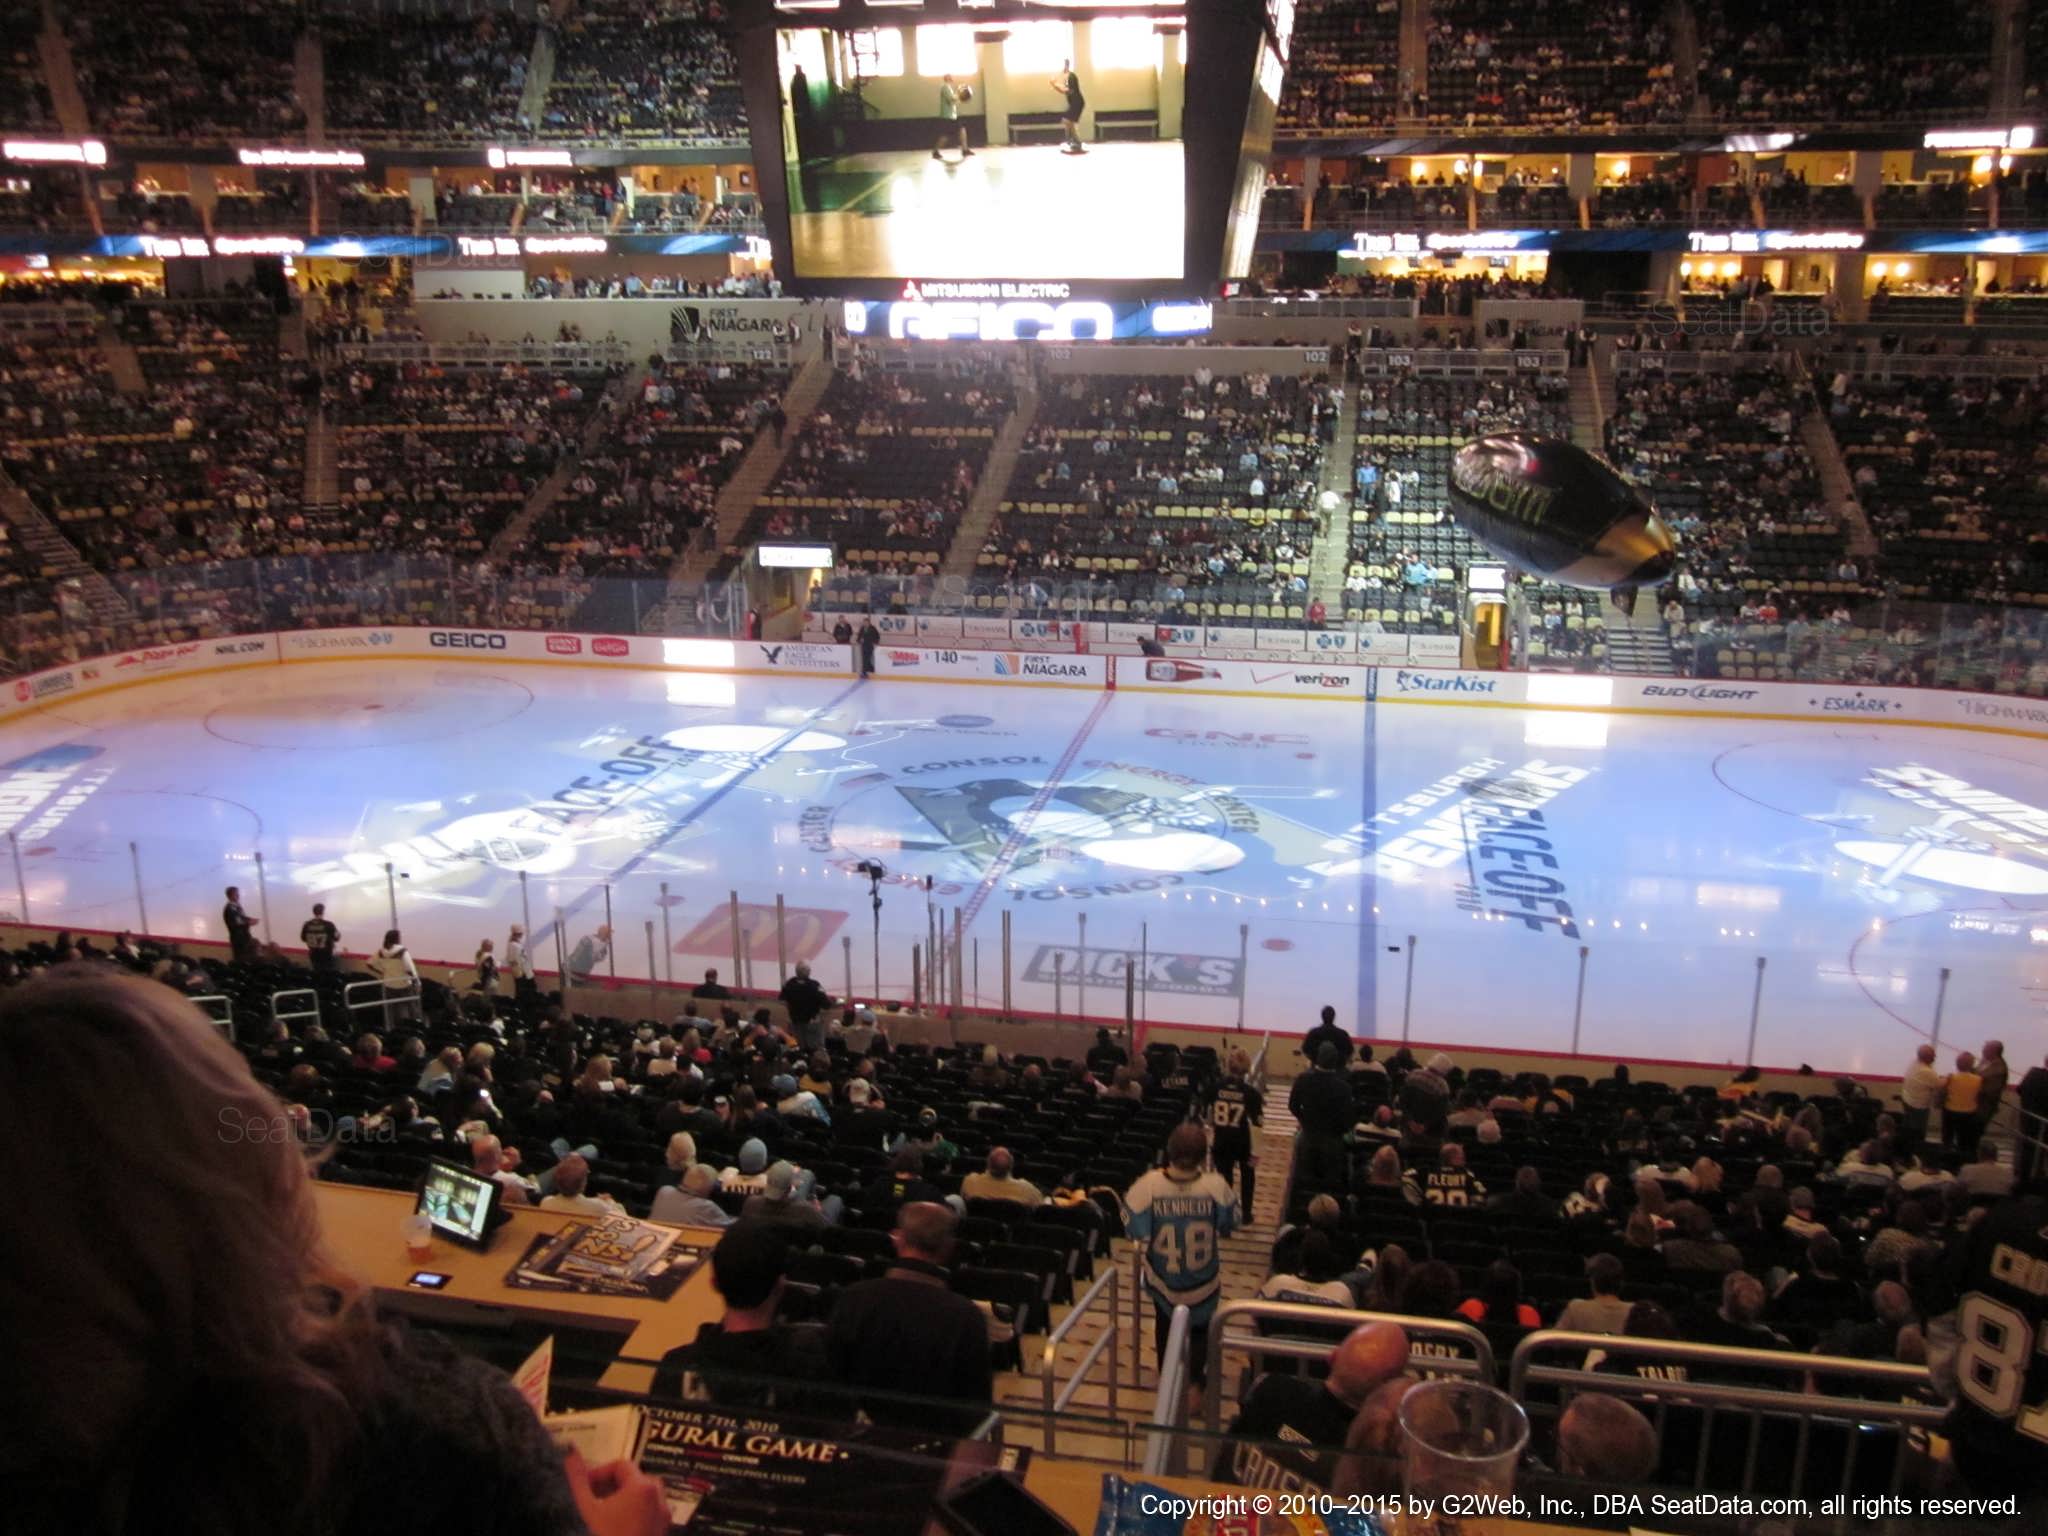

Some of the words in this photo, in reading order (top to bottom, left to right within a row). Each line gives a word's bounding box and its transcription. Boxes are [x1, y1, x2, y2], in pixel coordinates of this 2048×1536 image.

[1305, 351, 1328, 362] 102
[1388, 355, 1411, 366] 103
[1517, 357, 1540, 367] 103
[430, 632, 506, 649] GEICO
[1023, 664, 1087, 677] NIAGARA
[1295, 673, 1349, 688] verizon
[1411, 676, 1497, 693] StarKist
[1641, 685, 1688, 697] BUD
[1696, 687, 1759, 700] LIGHT
[1822, 697, 1890, 712] ESMARK
[901, 755, 1049, 774] CONSOL
[1214, 1101, 1244, 1128] 87
[1153, 1199, 1213, 1217] KENNEDY
[1153, 1222, 1214, 1274] 48
[743, 1419, 780, 1433] 2010
[745, 1435, 837, 1463] GAME
